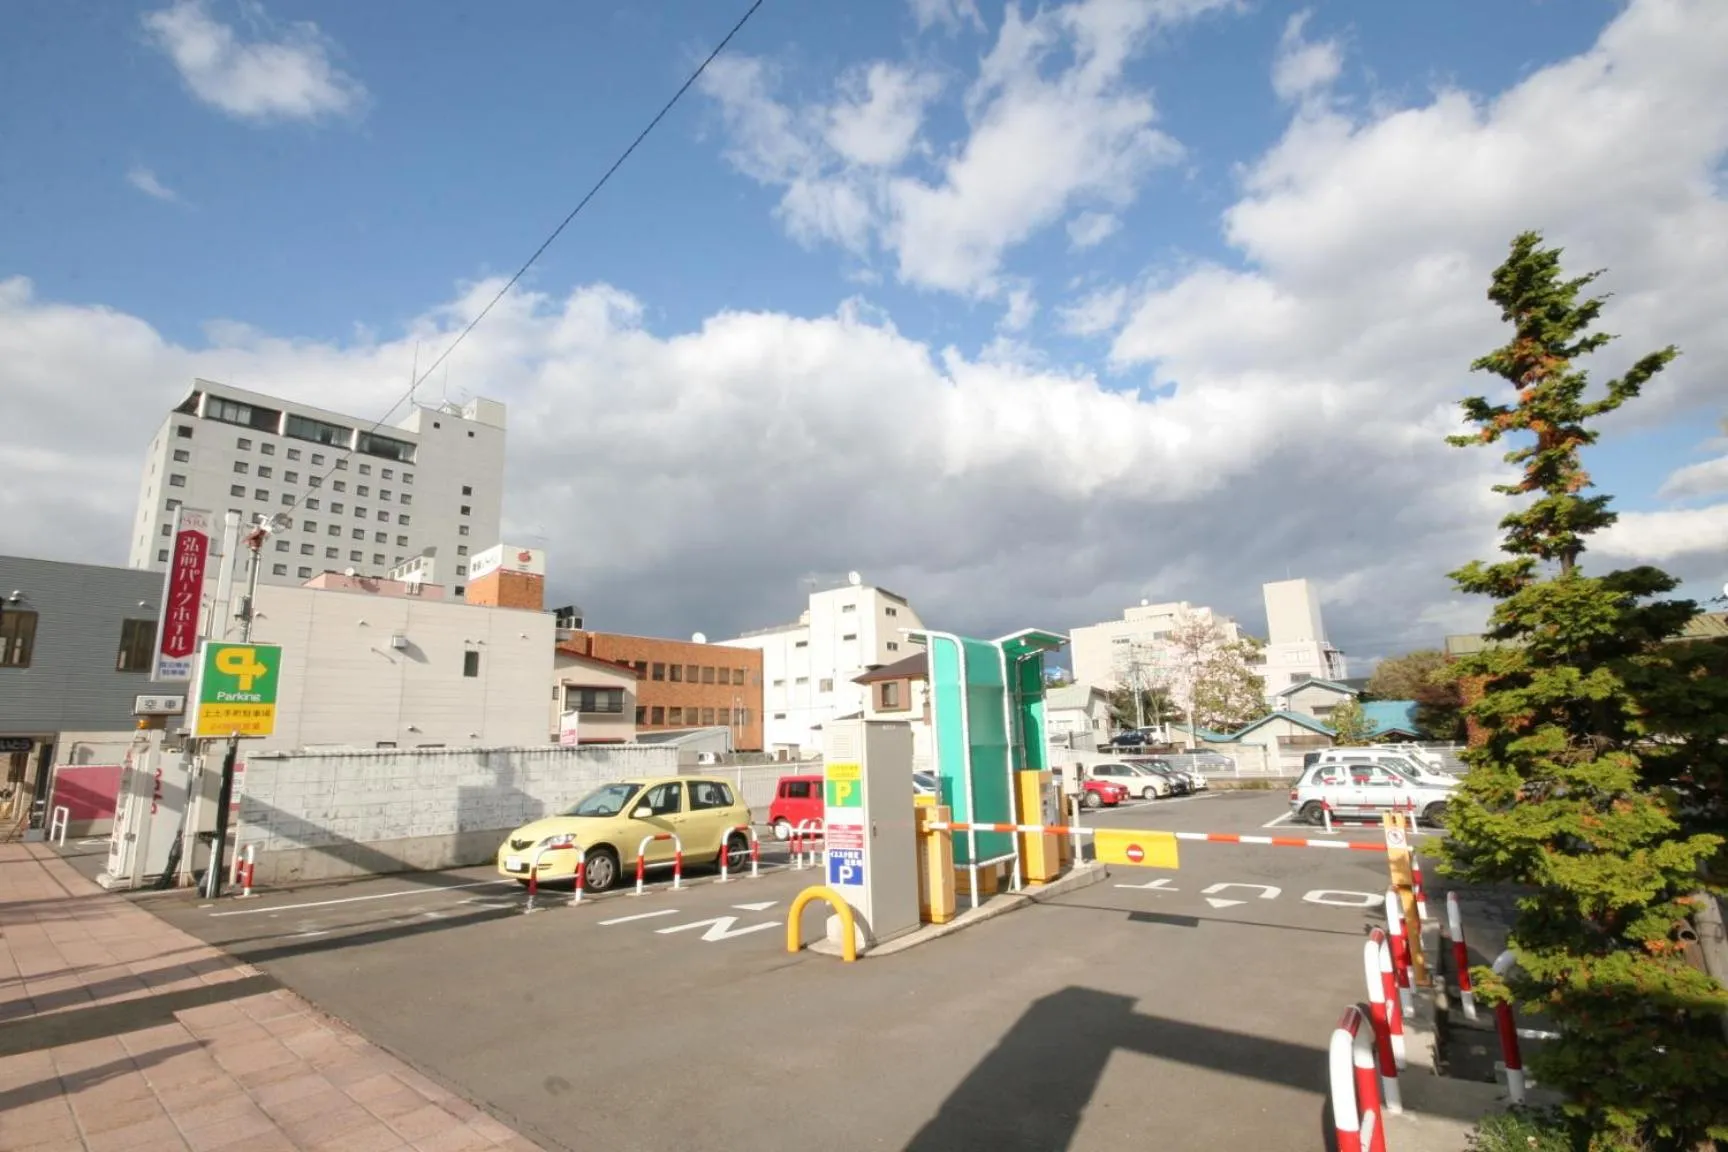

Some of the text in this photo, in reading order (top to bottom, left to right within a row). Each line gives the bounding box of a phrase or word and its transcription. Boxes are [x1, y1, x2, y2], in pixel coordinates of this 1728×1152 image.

[170, 536, 201, 651] 弘前パークホテル
[216, 691, 262, 702] Parking
[839, 865, 854, 885] P
